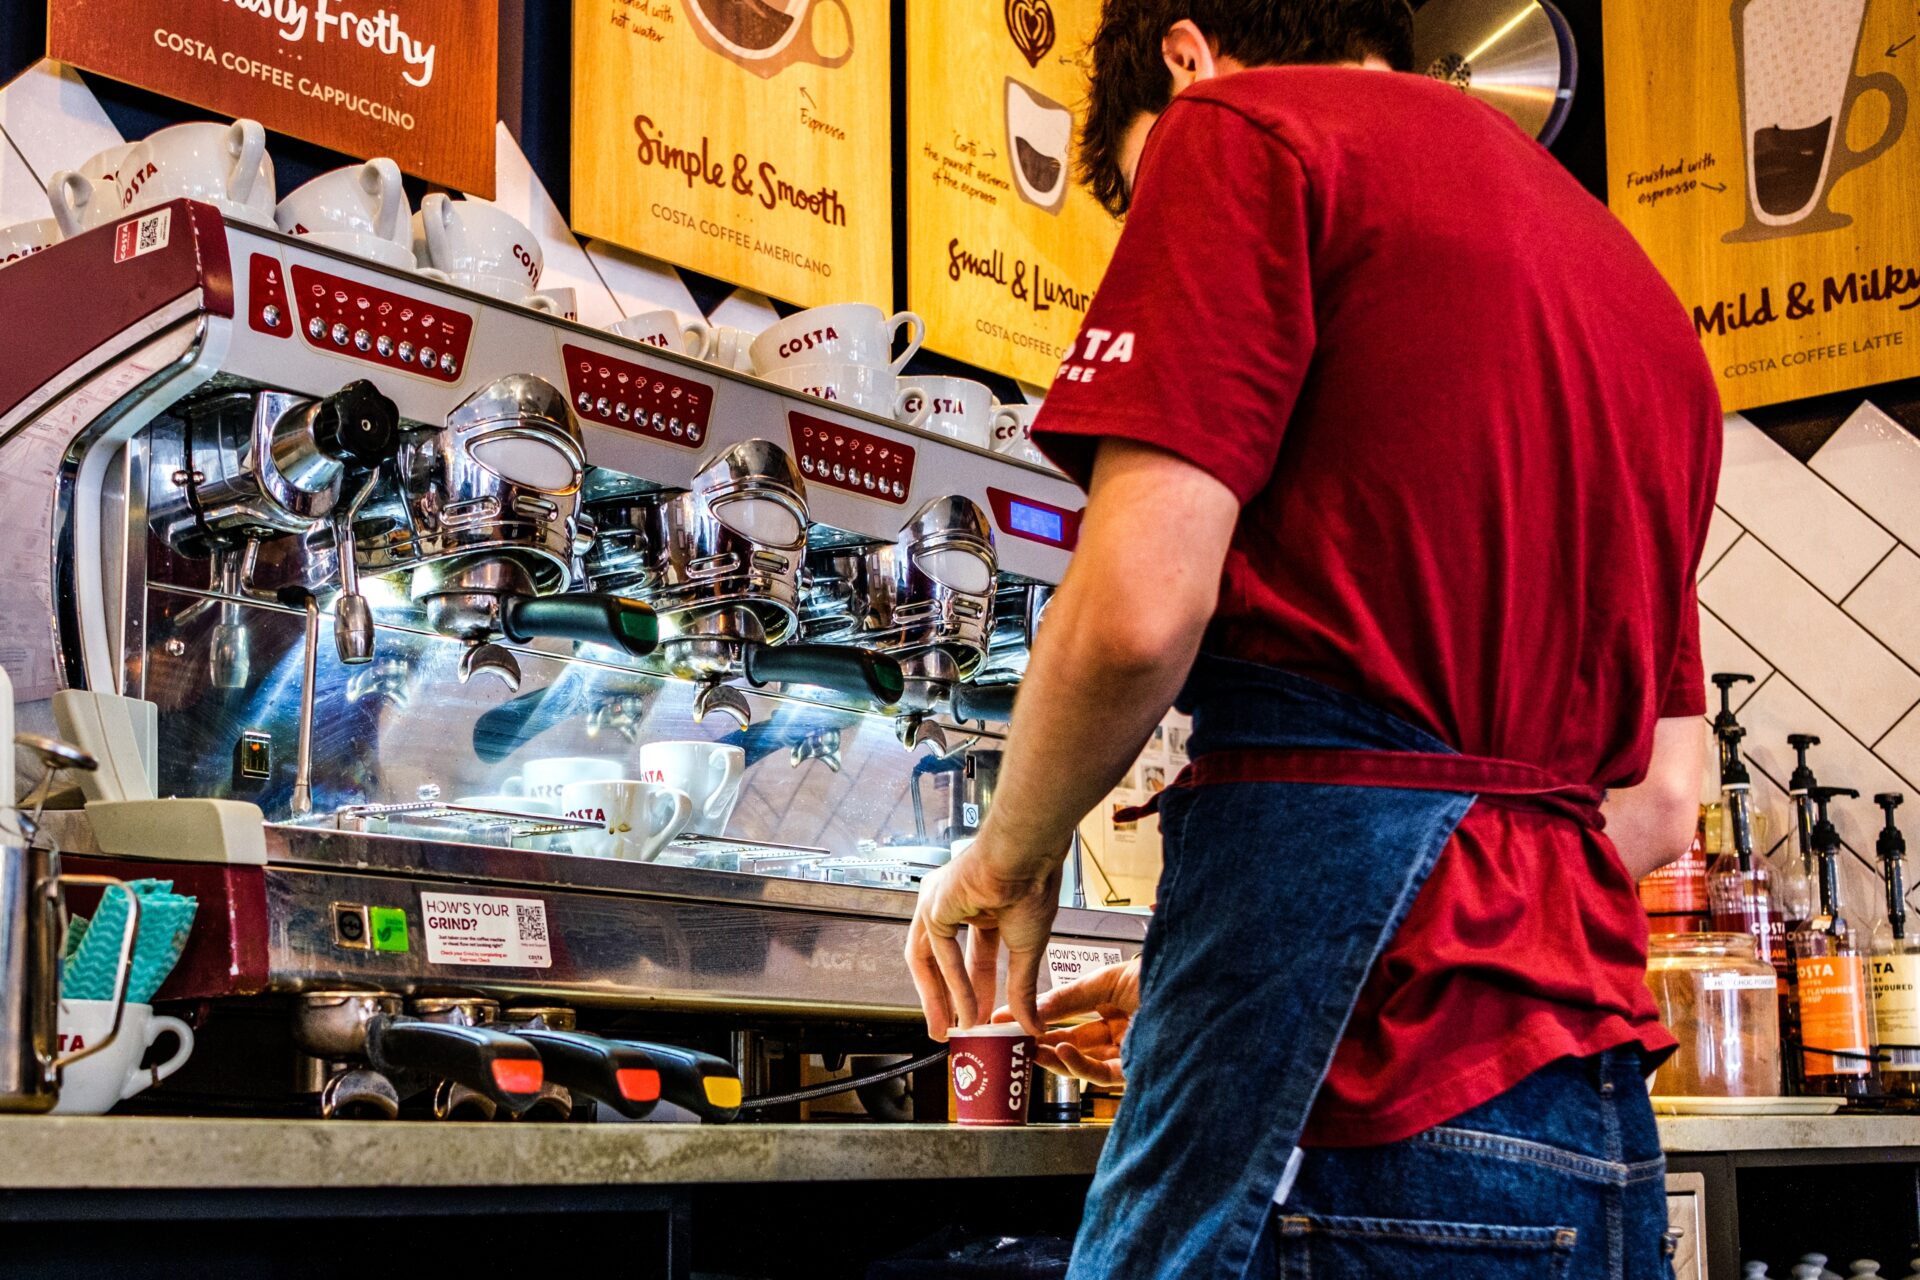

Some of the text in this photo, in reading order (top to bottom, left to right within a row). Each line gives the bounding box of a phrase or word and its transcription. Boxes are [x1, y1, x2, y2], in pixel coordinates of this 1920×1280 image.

[610, 9, 664, 42] hot water
[315, 0, 436, 87] Frothy
[154, 28, 416, 130] COSTA COFFEE CAPPUCCINO
[799, 107, 846, 141] Espresso
[634, 114, 847, 227] Simple & Smooth
[1687, 152, 1716, 174] with
[1638, 179, 1698, 208] espresso
[120, 224, 129, 260] COSTA
[651, 203, 832, 278] COSTA COFFEE AMERICANO
[948, 237, 1095, 314] Small & Luxur
[1694, 286, 1780, 340] Mild
[1785, 280, 1816, 321] &
[779, 325, 839, 359] COSTA
[976, 318, 1010, 343] COSTA
[1012, 329, 1052, 357] COFFEE
[1062, 327, 1136, 363] TA
[1723, 331, 1905, 380] COSTA COFFEE LATTE
[426, 899, 510, 918] HOW'S YOUR
[428, 916, 478, 931] GRIND?
[1049, 948, 1101, 962] HOW'S YOUR
[1050, 961, 1081, 973] GRIND?
[1796, 963, 1837, 980] OSTA
[964, 1051, 985, 1069] ITALIA
[1008, 1041, 1026, 1111] COSTA
[974, 1077, 989, 1098] TASTE
